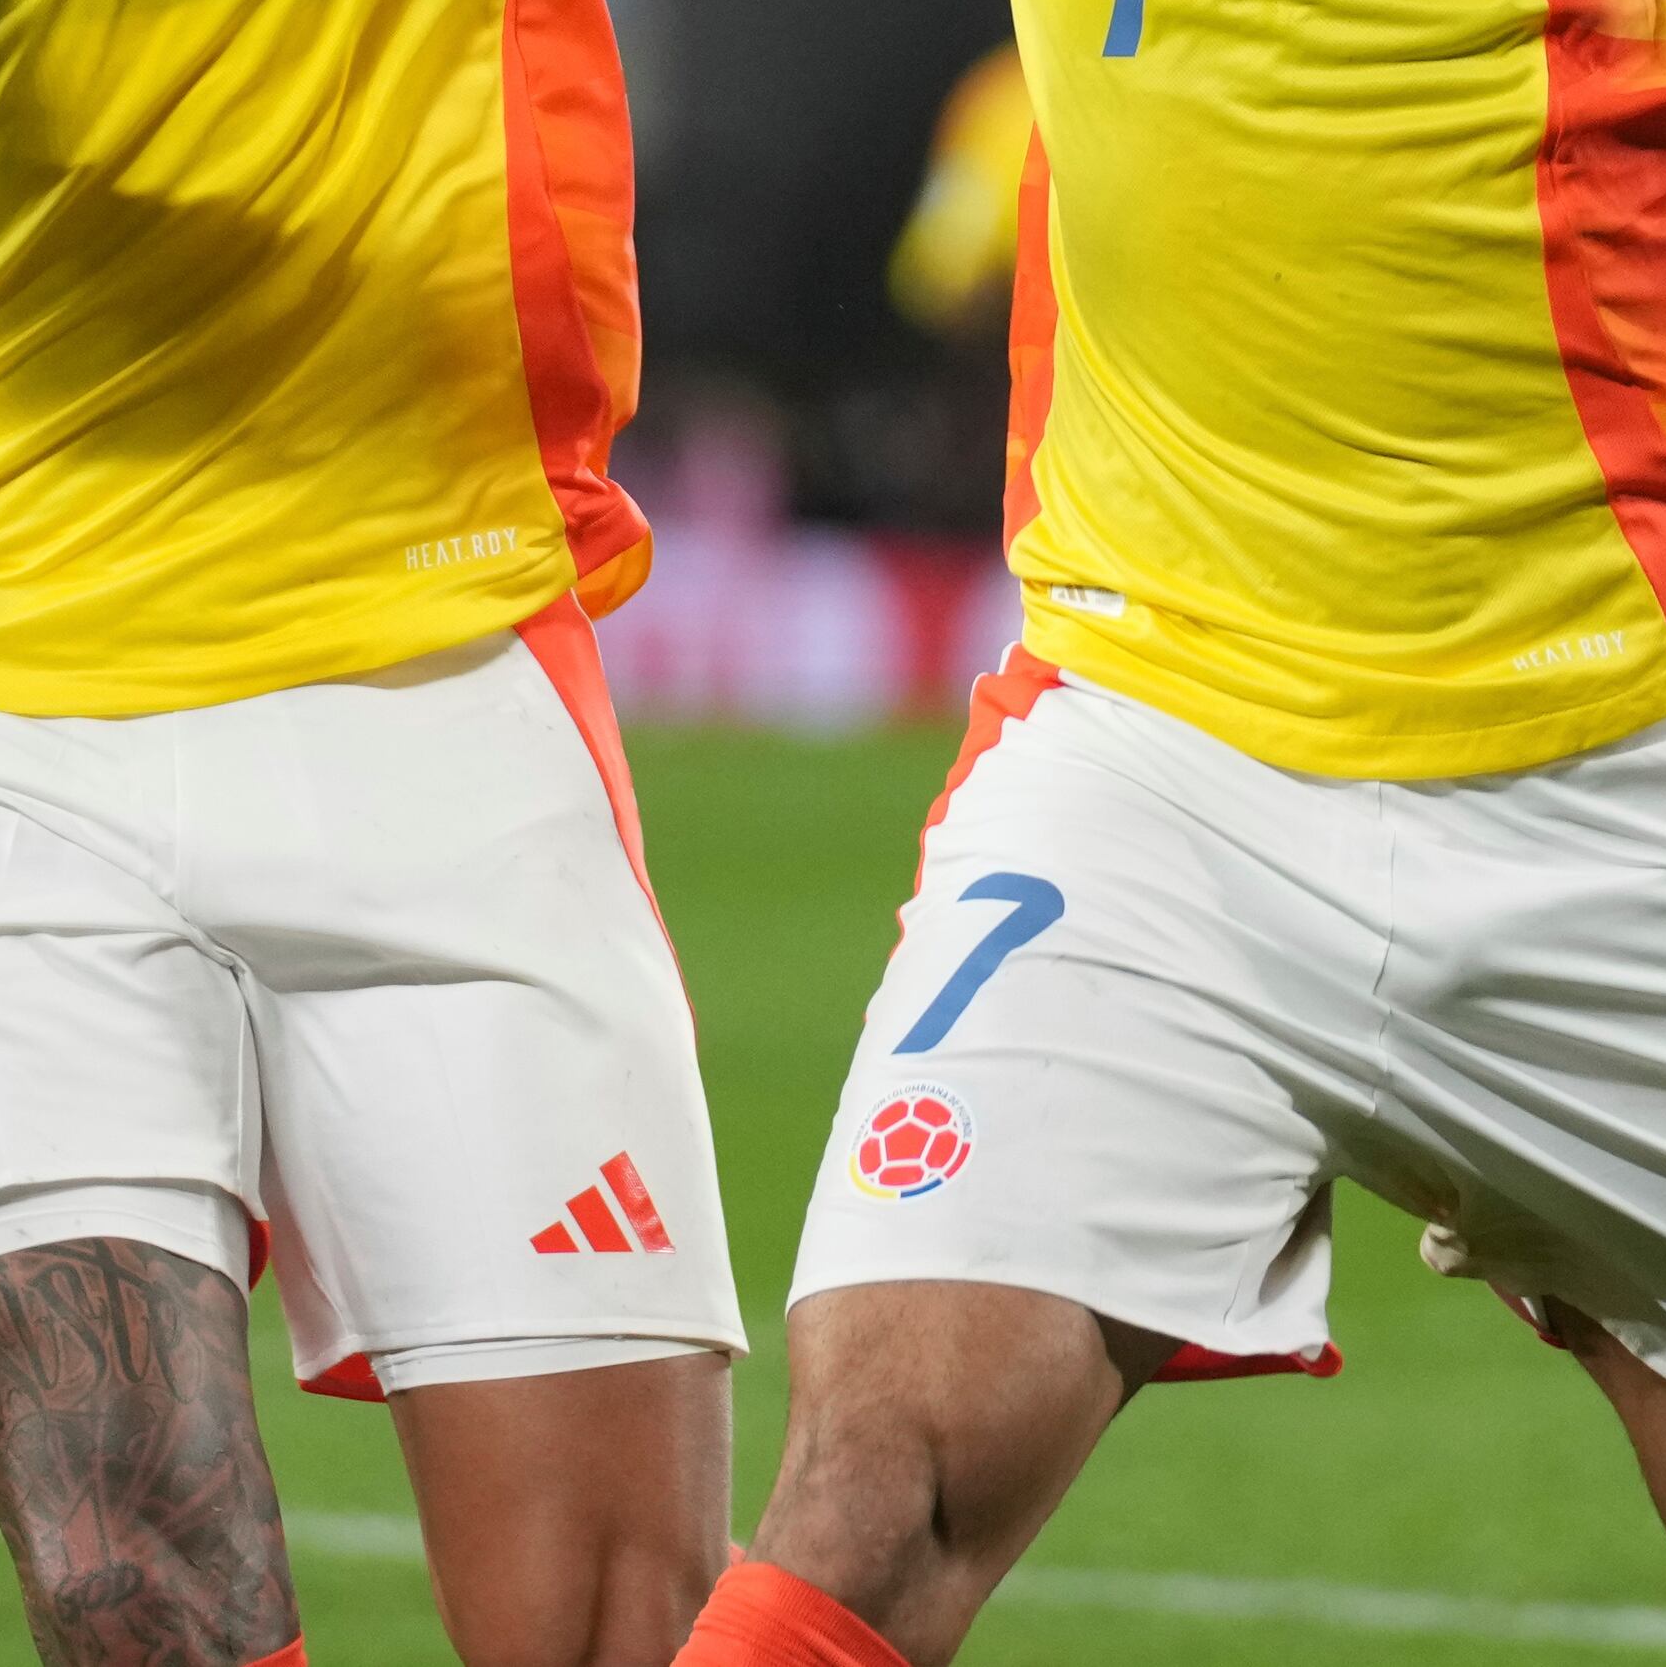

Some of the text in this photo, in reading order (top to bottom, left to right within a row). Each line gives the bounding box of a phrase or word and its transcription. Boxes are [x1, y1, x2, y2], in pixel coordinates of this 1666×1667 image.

[405, 525, 518, 571] HEAT.RDY
[1512, 630, 1625, 672] HEATRDY
[890, 871, 1066, 1056] 7
